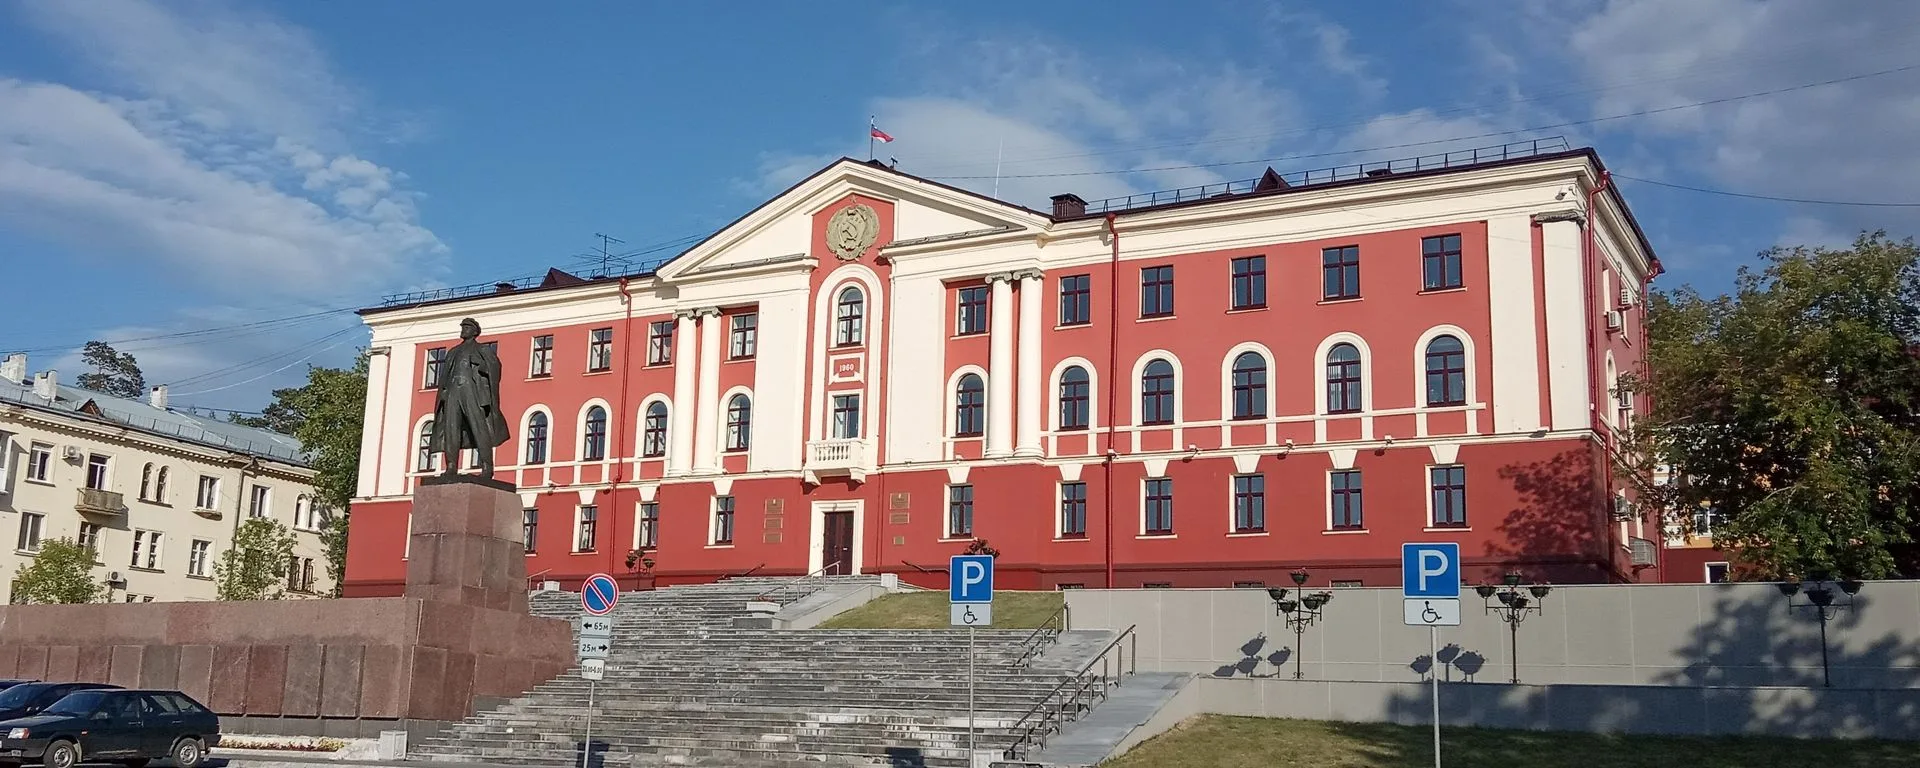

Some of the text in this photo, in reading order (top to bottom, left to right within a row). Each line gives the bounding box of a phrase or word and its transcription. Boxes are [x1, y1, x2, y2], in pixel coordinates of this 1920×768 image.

[839, 363, 855, 372] 1960
[962, 560, 985, 597] P
[1418, 549, 1449, 592] P
